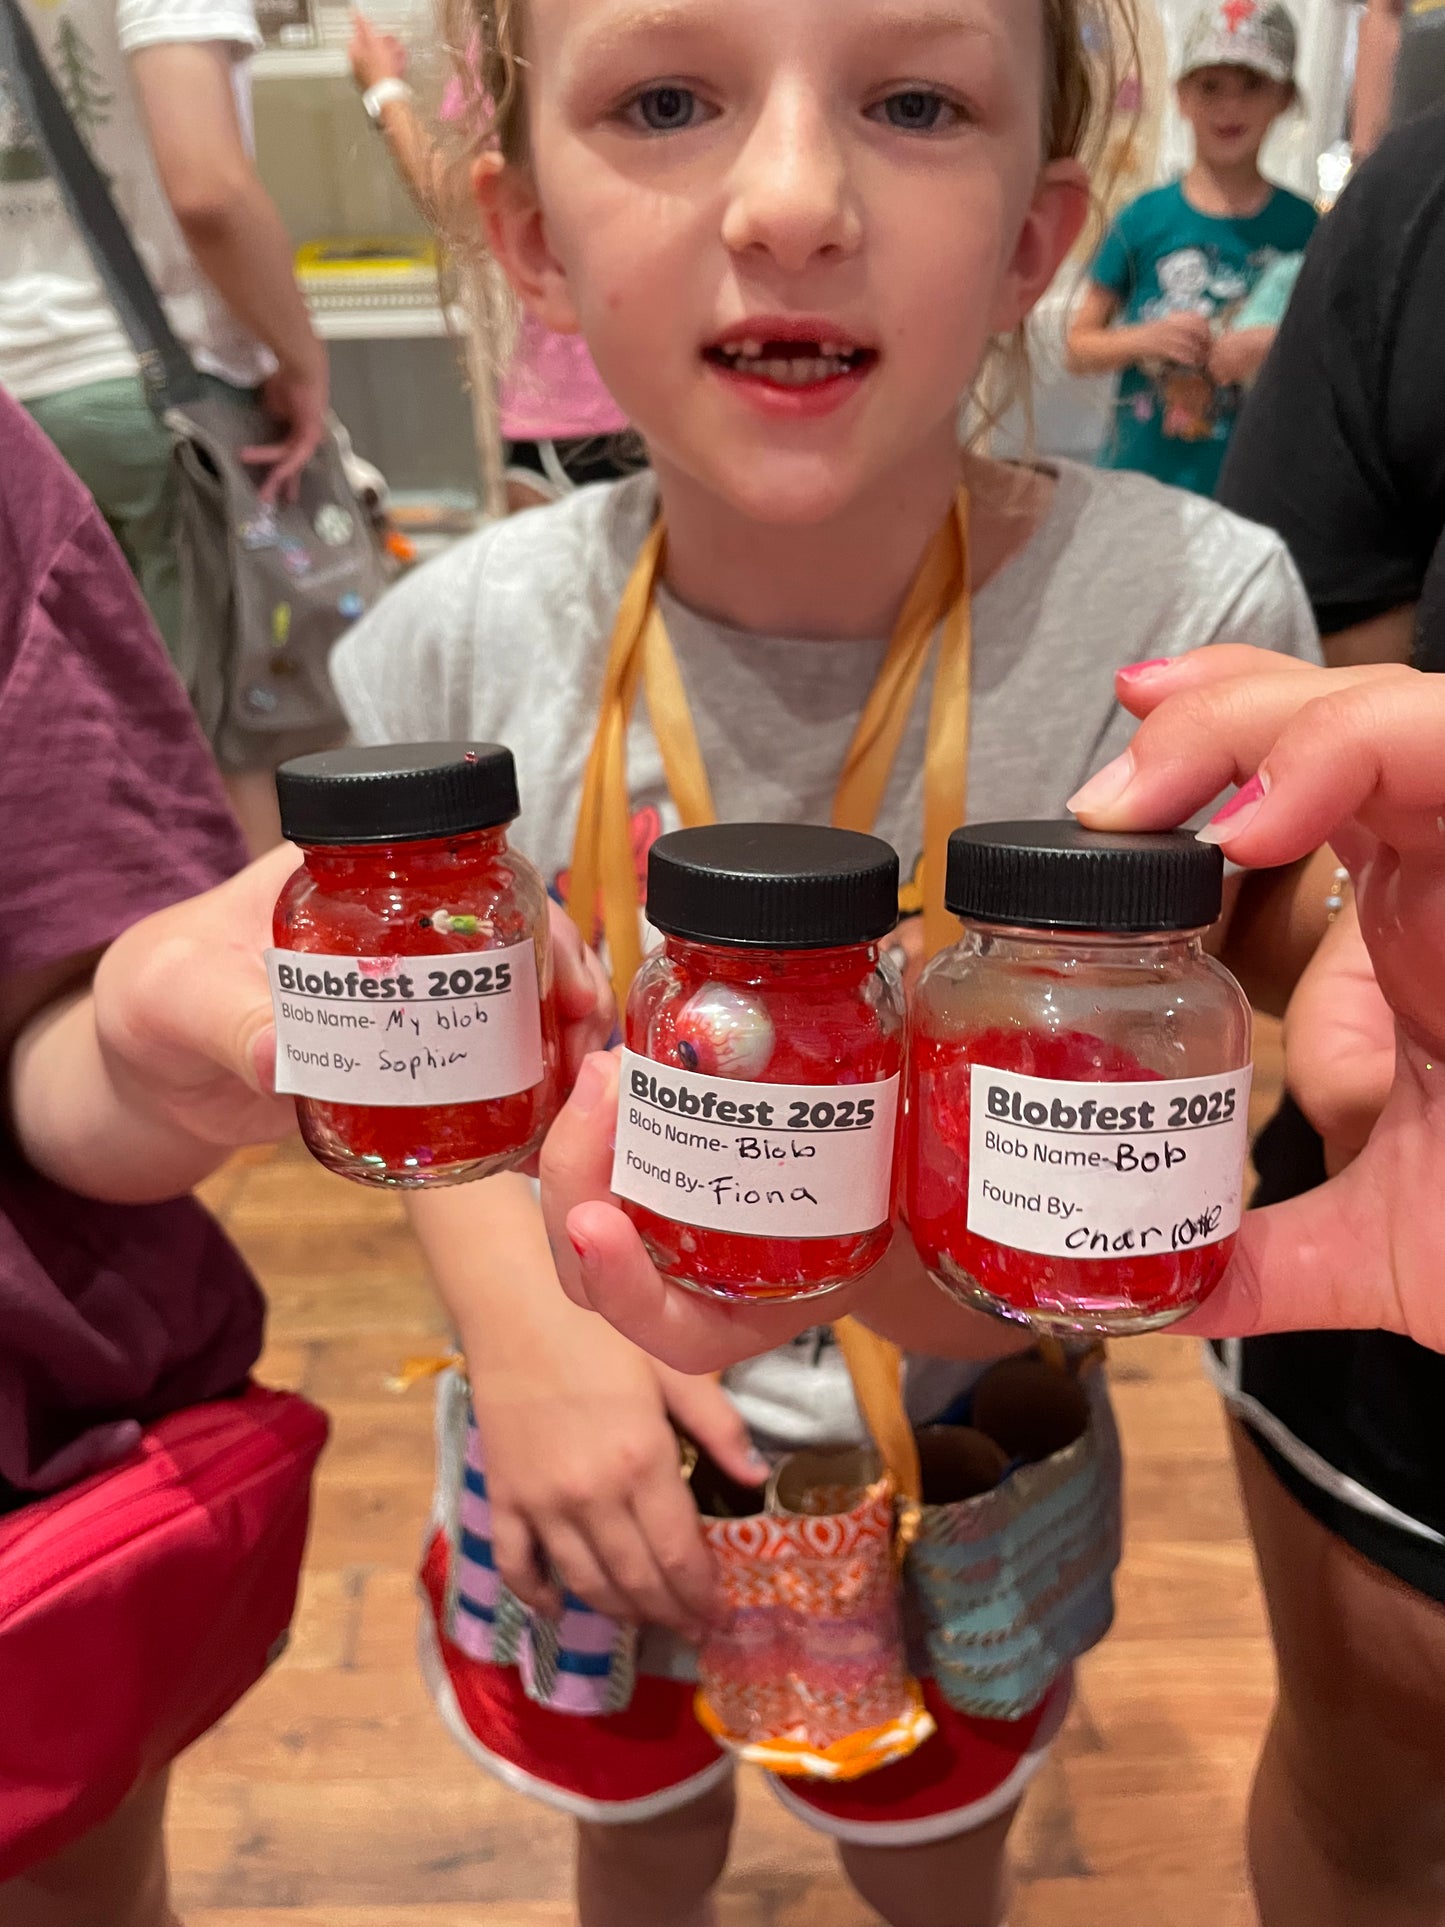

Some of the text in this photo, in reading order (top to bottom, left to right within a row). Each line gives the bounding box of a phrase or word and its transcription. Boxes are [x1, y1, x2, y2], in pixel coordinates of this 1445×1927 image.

[278, 963, 511, 999] Blobfest 2025
[282, 1003, 315, 1023] Blob
[287, 1044, 329, 1067] Found
[631, 1069, 875, 1128] Blobfest 2025
[987, 1086, 1236, 1130] Blobfest 2025
[629, 1108, 662, 1136] Blob
[735, 1137, 816, 1160] Blob
[985, 1131, 1028, 1159] Blob
[1110, 1141, 1187, 1173] Bob
[626, 1150, 670, 1184] Found
[708, 1176, 817, 1205] Fiona
[983, 1179, 1041, 1212] Found
